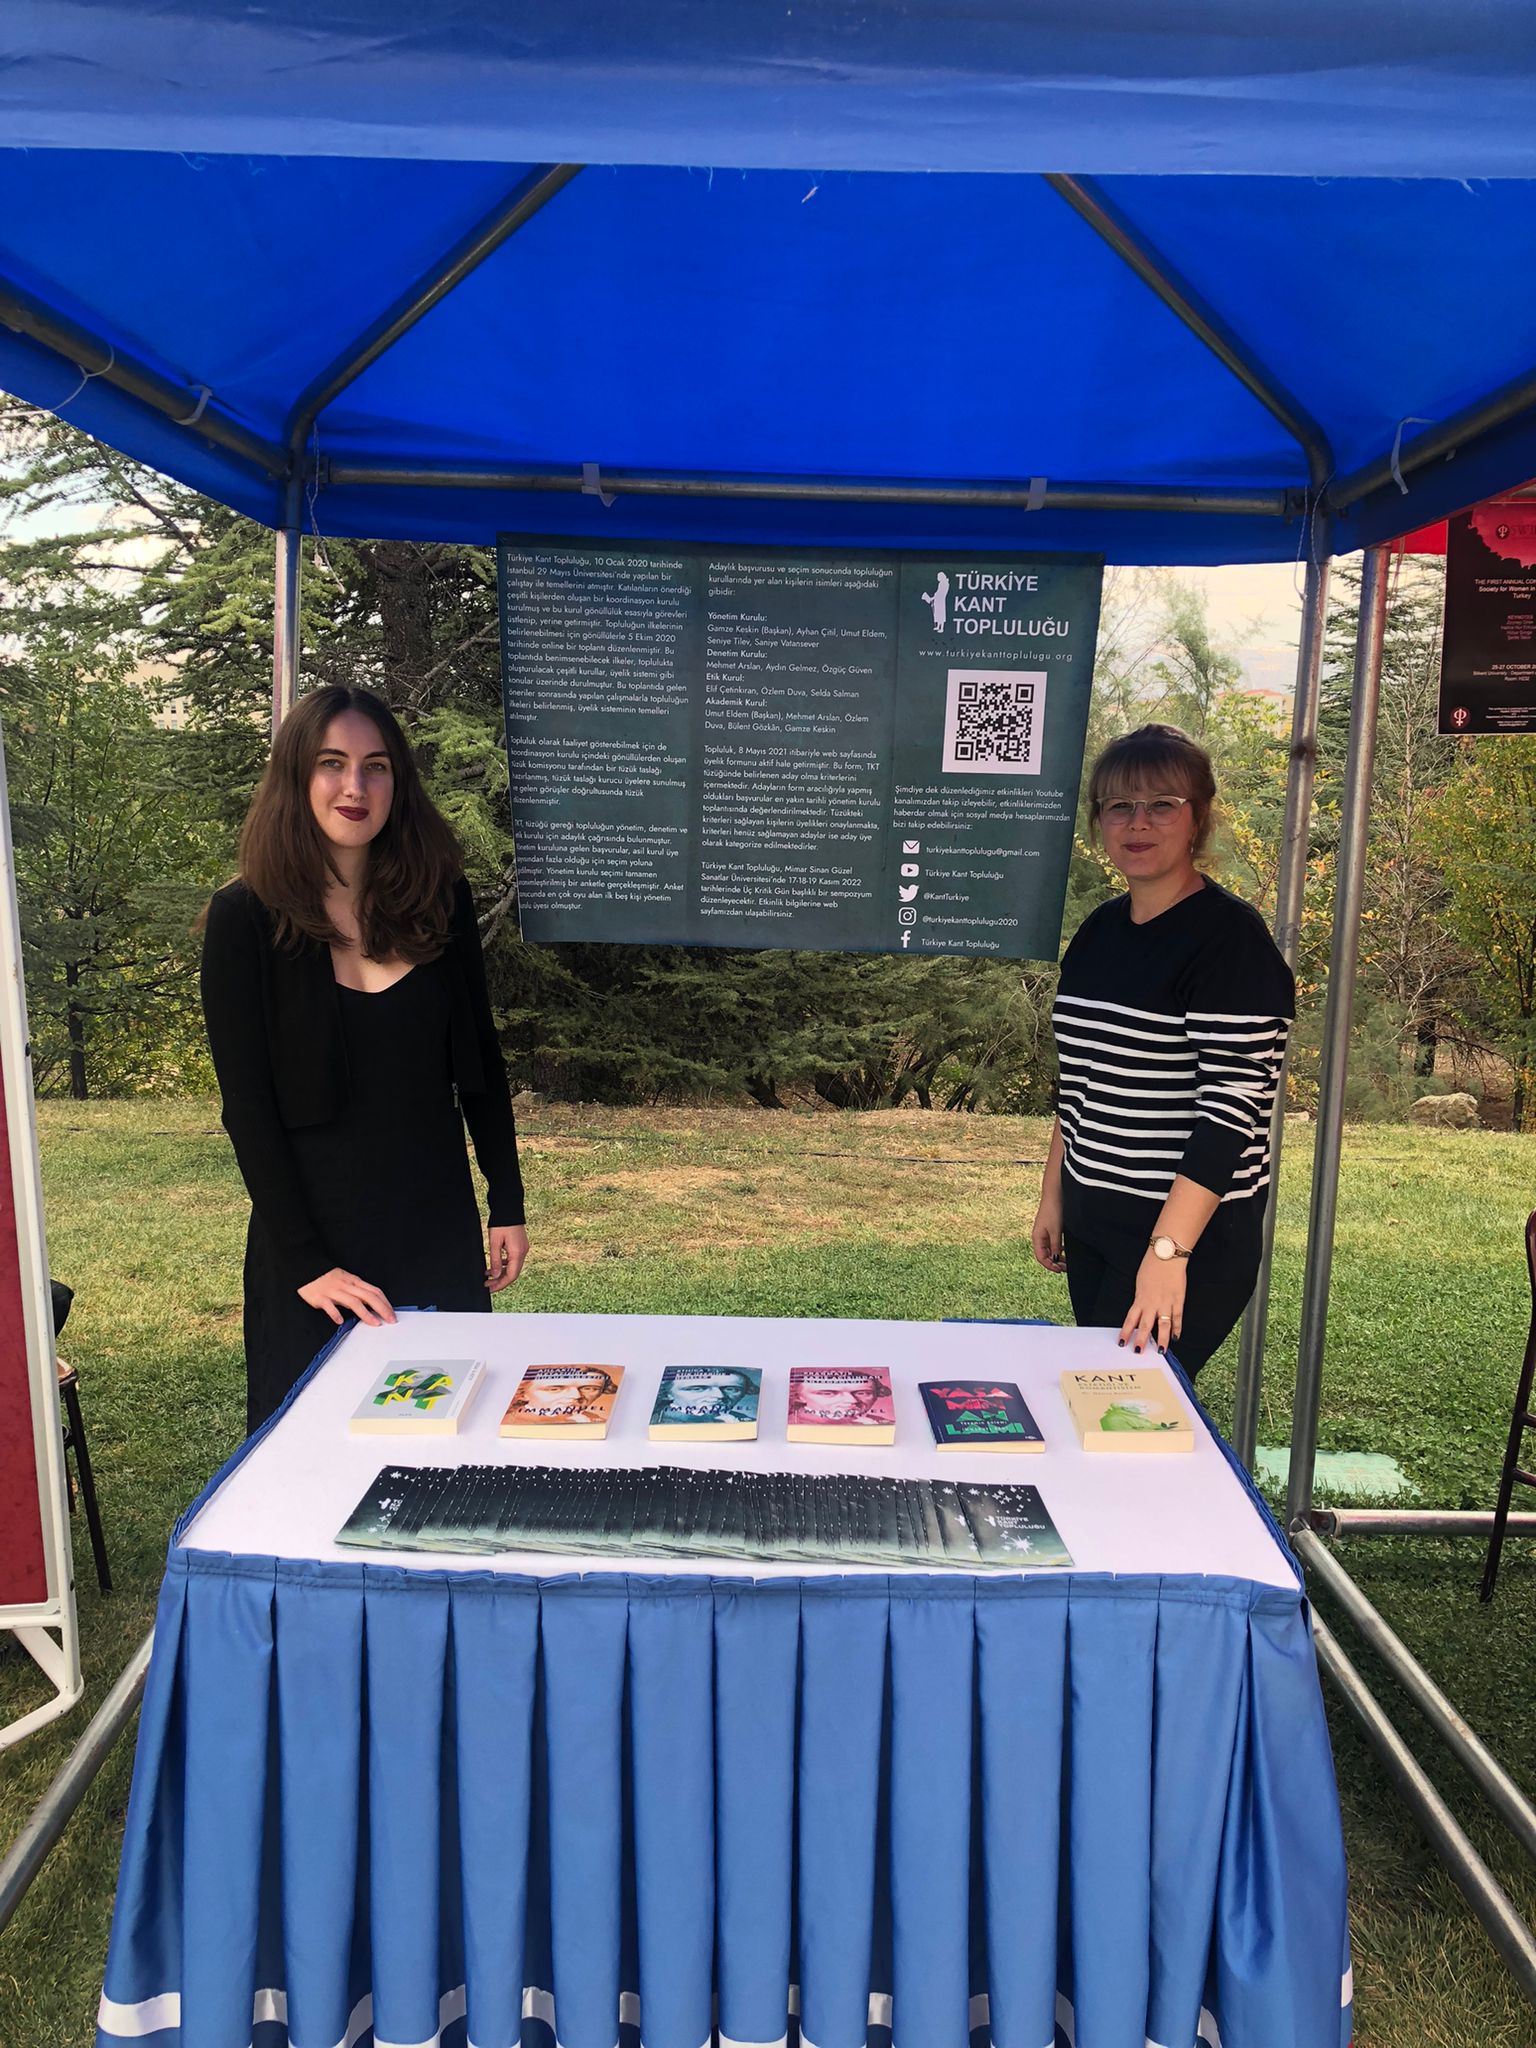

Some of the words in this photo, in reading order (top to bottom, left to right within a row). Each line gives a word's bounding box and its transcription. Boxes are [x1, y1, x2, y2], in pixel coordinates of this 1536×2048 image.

[508, 554, 532, 565] Türkiye
[535, 555, 551, 563] Kant
[594, 557, 603, 565] 10
[605, 558, 626, 566] Ocak
[626, 558, 648, 567] 2020
[650, 559, 682, 568] tarihinde
[536, 567, 547, 575] 29
[573, 567, 630, 578] Üniversitesi'nde
[660, 572, 671, 580] bir
[738, 563, 774, 574] başvurusu
[788, 565, 809, 575] seçim
[811, 565, 851, 574] sonucunda
[767, 577, 782, 585] alan
[785, 577, 813, 588] kişilerin
[815, 578, 842, 587] isimleri
[956, 571, 1038, 591] TÜRKİYE
[954, 596, 1007, 612] KANT
[708, 612, 737, 620] Yönetim
[740, 613, 767, 621] Kurulu:
[707, 624, 733, 633] Gamze
[735, 625, 759, 634] Keskin
[761, 626, 794, 637] (Başkan),
[796, 627, 819, 638] Ayhan
[821, 628, 839, 638] Çitil,
[839, 628, 860, 636] Umut
[862, 629, 887, 640] Eldem,
[953, 616, 1069, 636] TOPLULUĞU
[706, 636, 731, 647] Seniye
[733, 637, 752, 648] Tilev,
[754, 638, 778, 648] Saniye
[780, 638, 819, 647] Vatansever
[706, 648, 738, 657] Denetim
[741, 649, 767, 658] Kurulu:
[919, 649, 1073, 661] www.turkiyekanttoplulugu.org
[706, 661, 735, 669] Mehmet
[737, 662, 762, 673] Arslan,
[788, 663, 819, 674] Gelmez,
[822, 663, 846, 675] Özgüç
[848, 665, 872, 674] Güven
[706, 672, 720, 680] Etik
[722, 673, 744, 681] Kurul:
[706, 685, 717, 693] Elif
[760, 685, 785, 695] Özlem
[787, 687, 808, 698] Duva,
[810, 688, 830, 696] Selda
[832, 689, 859, 697] Salman
[705, 697, 742, 706] Akademik
[745, 698, 767, 706] Kurul:
[705, 709, 724, 717] Umut
[726, 710, 748, 718] Eldem
[751, 710, 783, 722] (Başkan),
[786, 712, 815, 720] Mehmet
[816, 712, 842, 723] Arslan,
[844, 712, 868, 722] Özlem
[704, 720, 725, 731] Duva,
[728, 721, 750, 730] Bülent
[751, 722, 782, 733] Gözkân,
[784, 724, 810, 732] Gamze
[812, 724, 835, 733] Keskin
[538, 738, 560, 746] olarak
[562, 738, 588, 750] faaliyet
[589, 740, 640, 752] gösterebilmek
[642, 742, 655, 752] için
[657, 742, 666, 750] de
[895, 786, 923, 796] Şimdiye
[924, 786, 938, 794] dek
[997, 788, 1033, 796] etkinlikleri
[1036, 788, 1063, 797] Youtube
[942, 798, 959, 808] takip
[961, 798, 997, 809] izleyebilir,
[1000, 799, 1061, 808] etkinliklerimizden
[893, 808, 926, 817] haberdar
[928, 809, 949, 818] olmak
[950, 810, 963, 820] için
[966, 810, 987, 821] sosyal
[989, 811, 1013, 822] medya
[893, 820, 906, 828] bizi
[908, 820, 926, 830] takip
[926, 820, 972, 830] edebilirsiniz:
[702, 861, 726, 872] Türkiye
[728, 862, 744, 870] Kant
[784, 864, 807, 872] Mimar
[809, 865, 829, 873] Sinan
[831, 865, 852, 874] Güzel
[701, 873, 729, 881] Sanatlar
[731, 872, 786, 883] Üniversitesi'nde
[788, 875, 817, 884] 17-18-19
[842, 877, 862, 886] 2022
[925, 869, 950, 880] Türkiye
[952, 870, 967, 878] Kant
[701, 885, 741, 894] tarihlerinde
[742, 884, 752, 896] Üç
[754, 886, 772, 894] Kritik
[774, 887, 790, 895] Gün
[818, 888, 828, 896] bir
[830, 891, 872, 900] sempozyum
[923, 892, 969, 903] @KantTurkiye
[759, 897, 783, 906] Etkinlik
[785, 898, 821, 909] bilgilerine
[823, 899, 838, 907] web
[922, 915, 1018, 927] @turkiyekanttoplulugu2020
[921, 938, 946, 948] Türkiye
[948, 938, 963, 947] Kant
[1074, 1374, 1137, 1382] KANT
